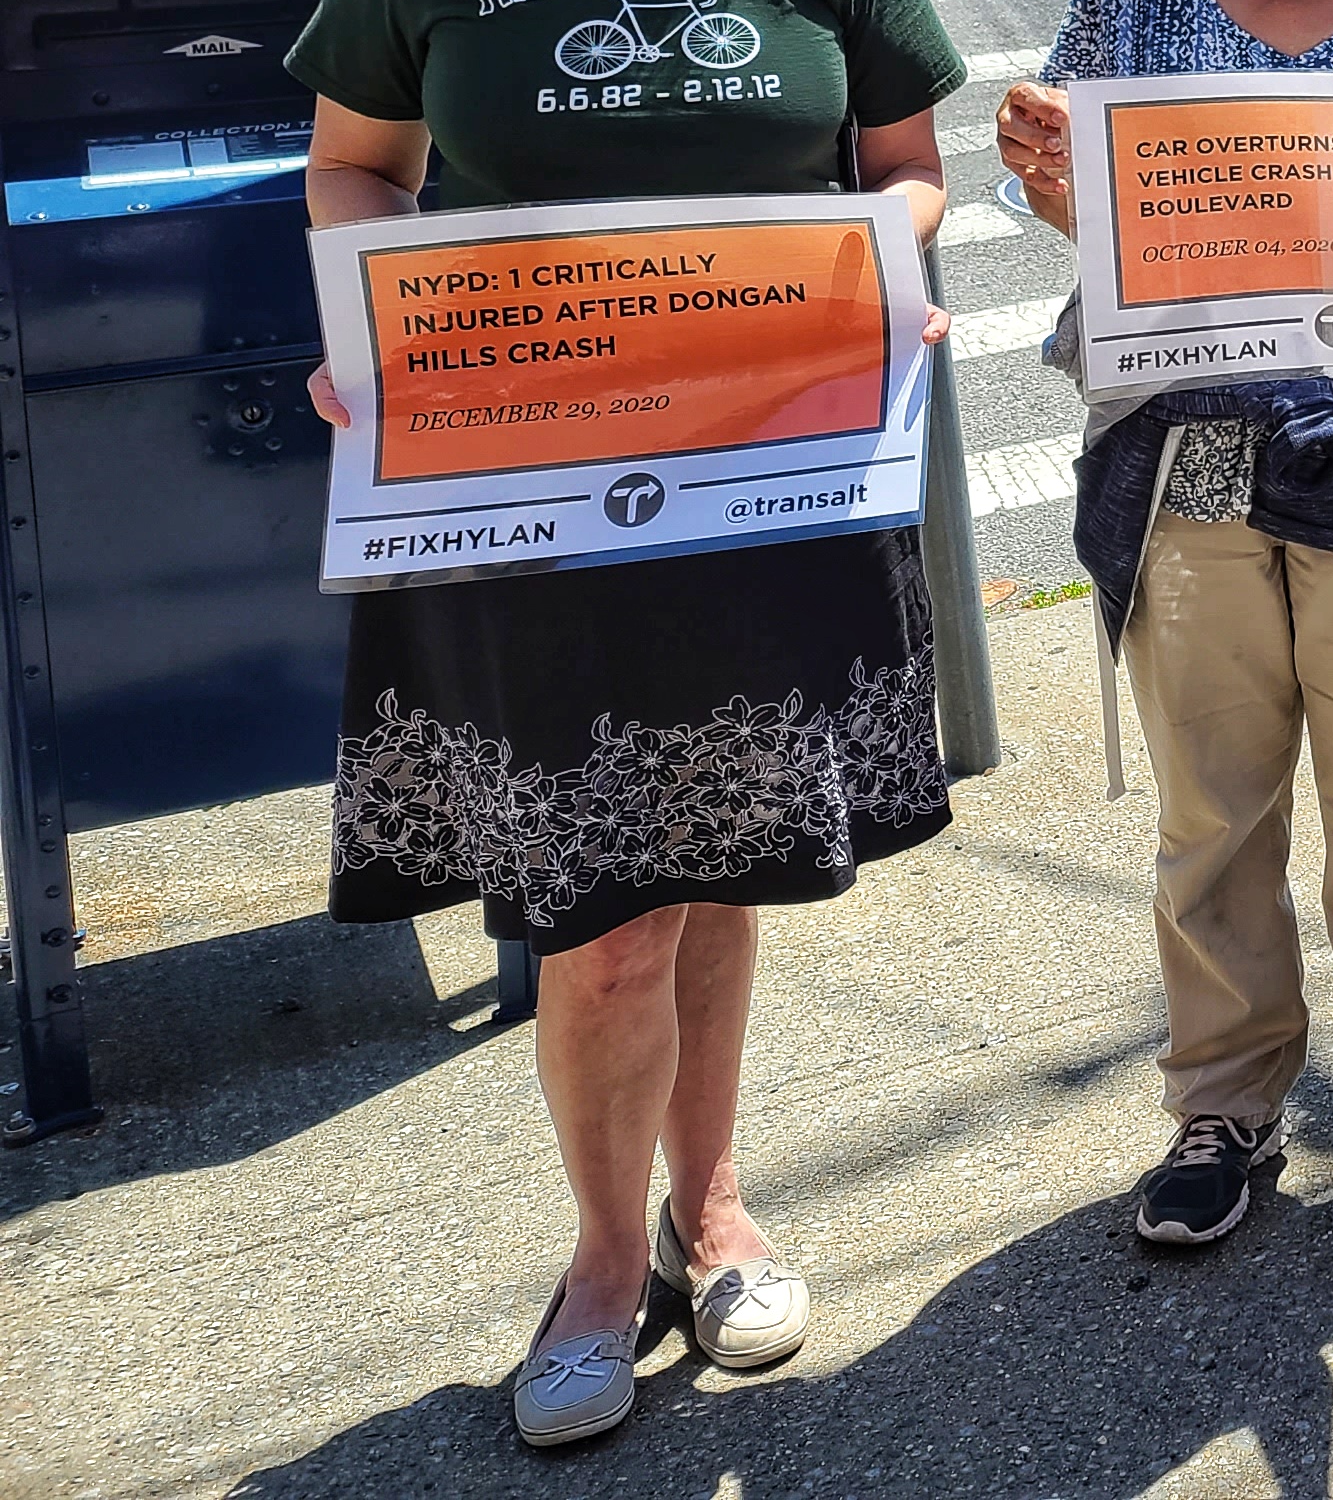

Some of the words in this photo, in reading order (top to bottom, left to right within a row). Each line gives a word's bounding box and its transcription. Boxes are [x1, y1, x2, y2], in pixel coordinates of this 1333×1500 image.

[191, 41, 236, 55] MAIL
[536, 85, 642, 114] 6.6.82
[683, 74, 782, 104] 2.12.12
[154, 121, 292, 141] COLLECTION
[1136, 139, 1188, 159] CAR
[1136, 165, 1243, 188] VEHICLE
[1250, 163, 1332, 182] CRASH
[1139, 192, 1294, 218] BOULEVARD
[1141, 239, 1250, 264] OCTOBER
[1254, 240, 1287, 259] 04,
[398, 269, 500, 299] NYPD:
[508, 268, 521, 289] 1
[530, 253, 717, 288] CRITICALLY
[403, 304, 544, 336] INJURED
[555, 296, 658, 324] AFTER
[670, 282, 807, 315] DONGAN
[408, 345, 498, 374] HILLS
[507, 335, 617, 362] CRASH
[1117, 338, 1278, 374] #FIXHYLAN
[408, 402, 558, 433] DECEMBER
[563, 400, 602, 422] 29,
[608, 394, 671, 415] 2020
[362, 520, 557, 560] #FIXHYLAN
[723, 483, 868, 524] @transalt
